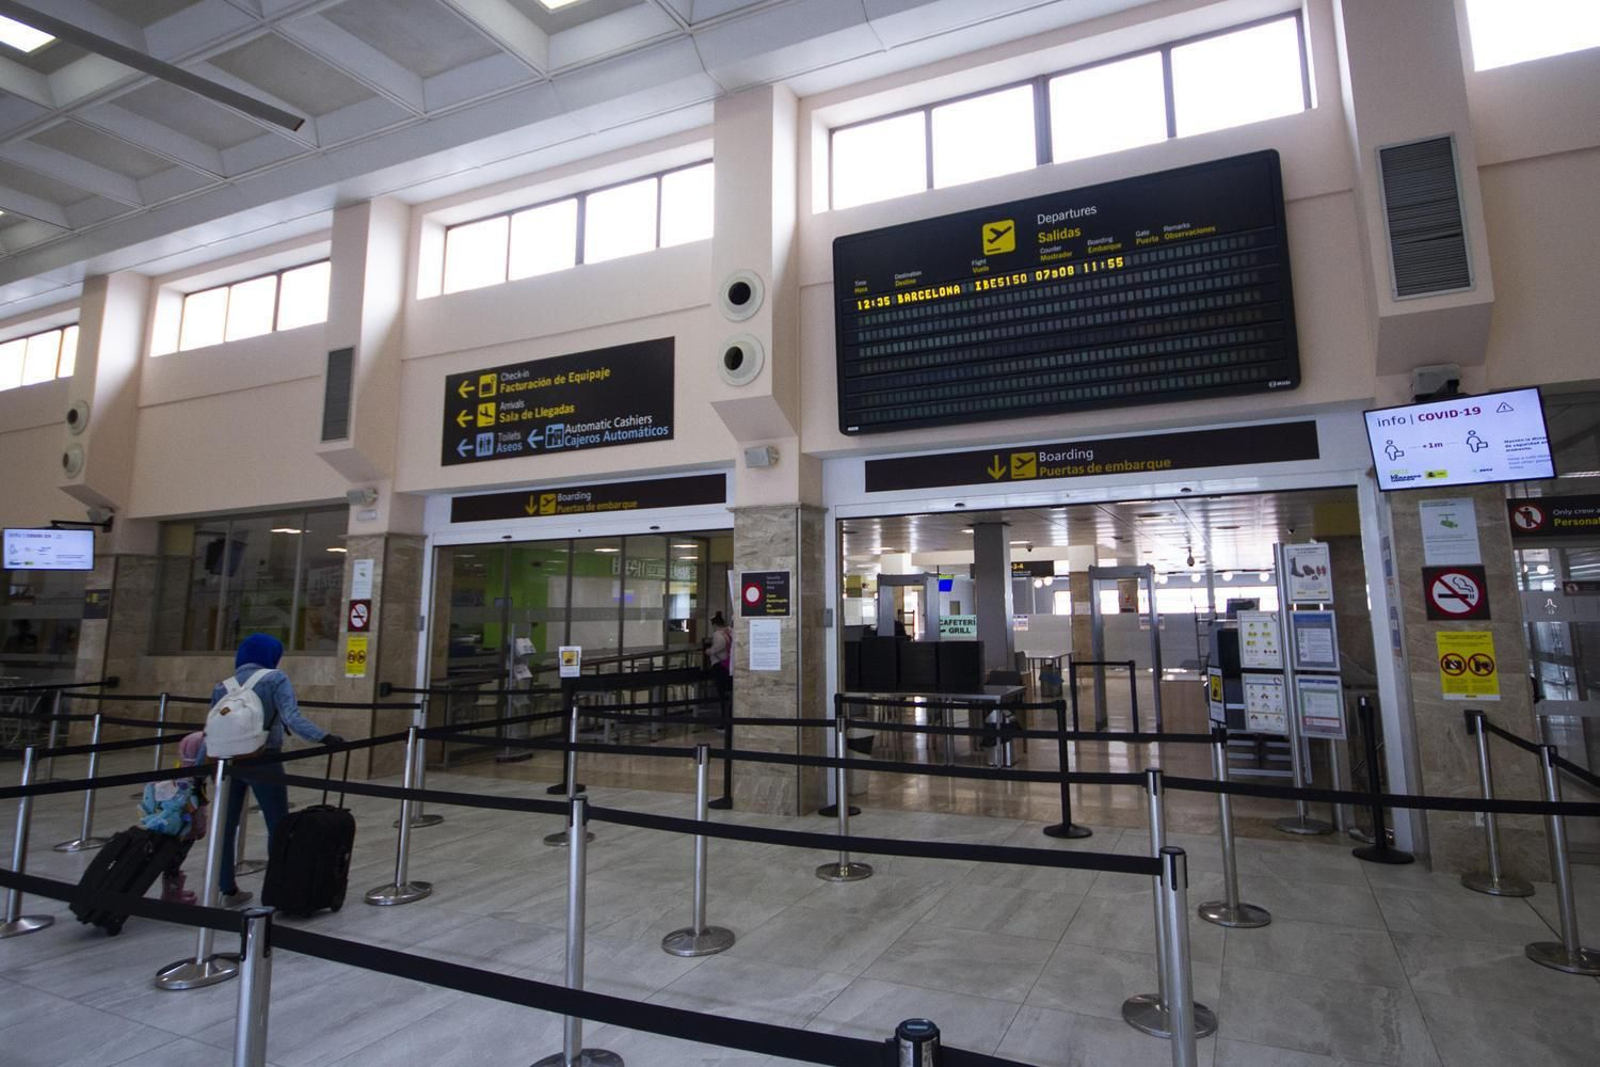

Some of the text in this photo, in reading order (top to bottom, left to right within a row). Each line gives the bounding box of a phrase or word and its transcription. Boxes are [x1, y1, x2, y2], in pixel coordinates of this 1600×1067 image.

[1037, 205, 1098, 225] Departures
[1038, 226, 1082, 244] Salidas
[1136, 235, 1159, 246] Puerta
[1164, 225, 1216, 240] Observaciones
[857, 296, 890, 310] 12:35
[897, 285, 960, 304] BARCELONA
[975, 273, 1028, 291] IBE5150
[1083, 256, 1124, 274] 11:55
[500, 369, 530, 382] Check-in
[500, 367, 611, 394] Facturación de Equipaje
[500, 398, 525, 410] Arrivals
[499, 403, 575, 423] Sala de Llegadas
[1377, 415, 1406, 427] info
[1418, 406, 1482, 422] COVID-19
[565, 414, 653, 434] Automatic Cashiers
[497, 431, 521, 442] Toilets
[564, 423, 670, 448] Cajeros Automáticos
[496, 441, 523, 453] Aseos
[1039, 449, 1094, 463] Boarding
[1040, 458, 1172, 477] Puertas de embarque
[557, 491, 592, 503] Boarding
[557, 499, 638, 513] Puertas de embarque
